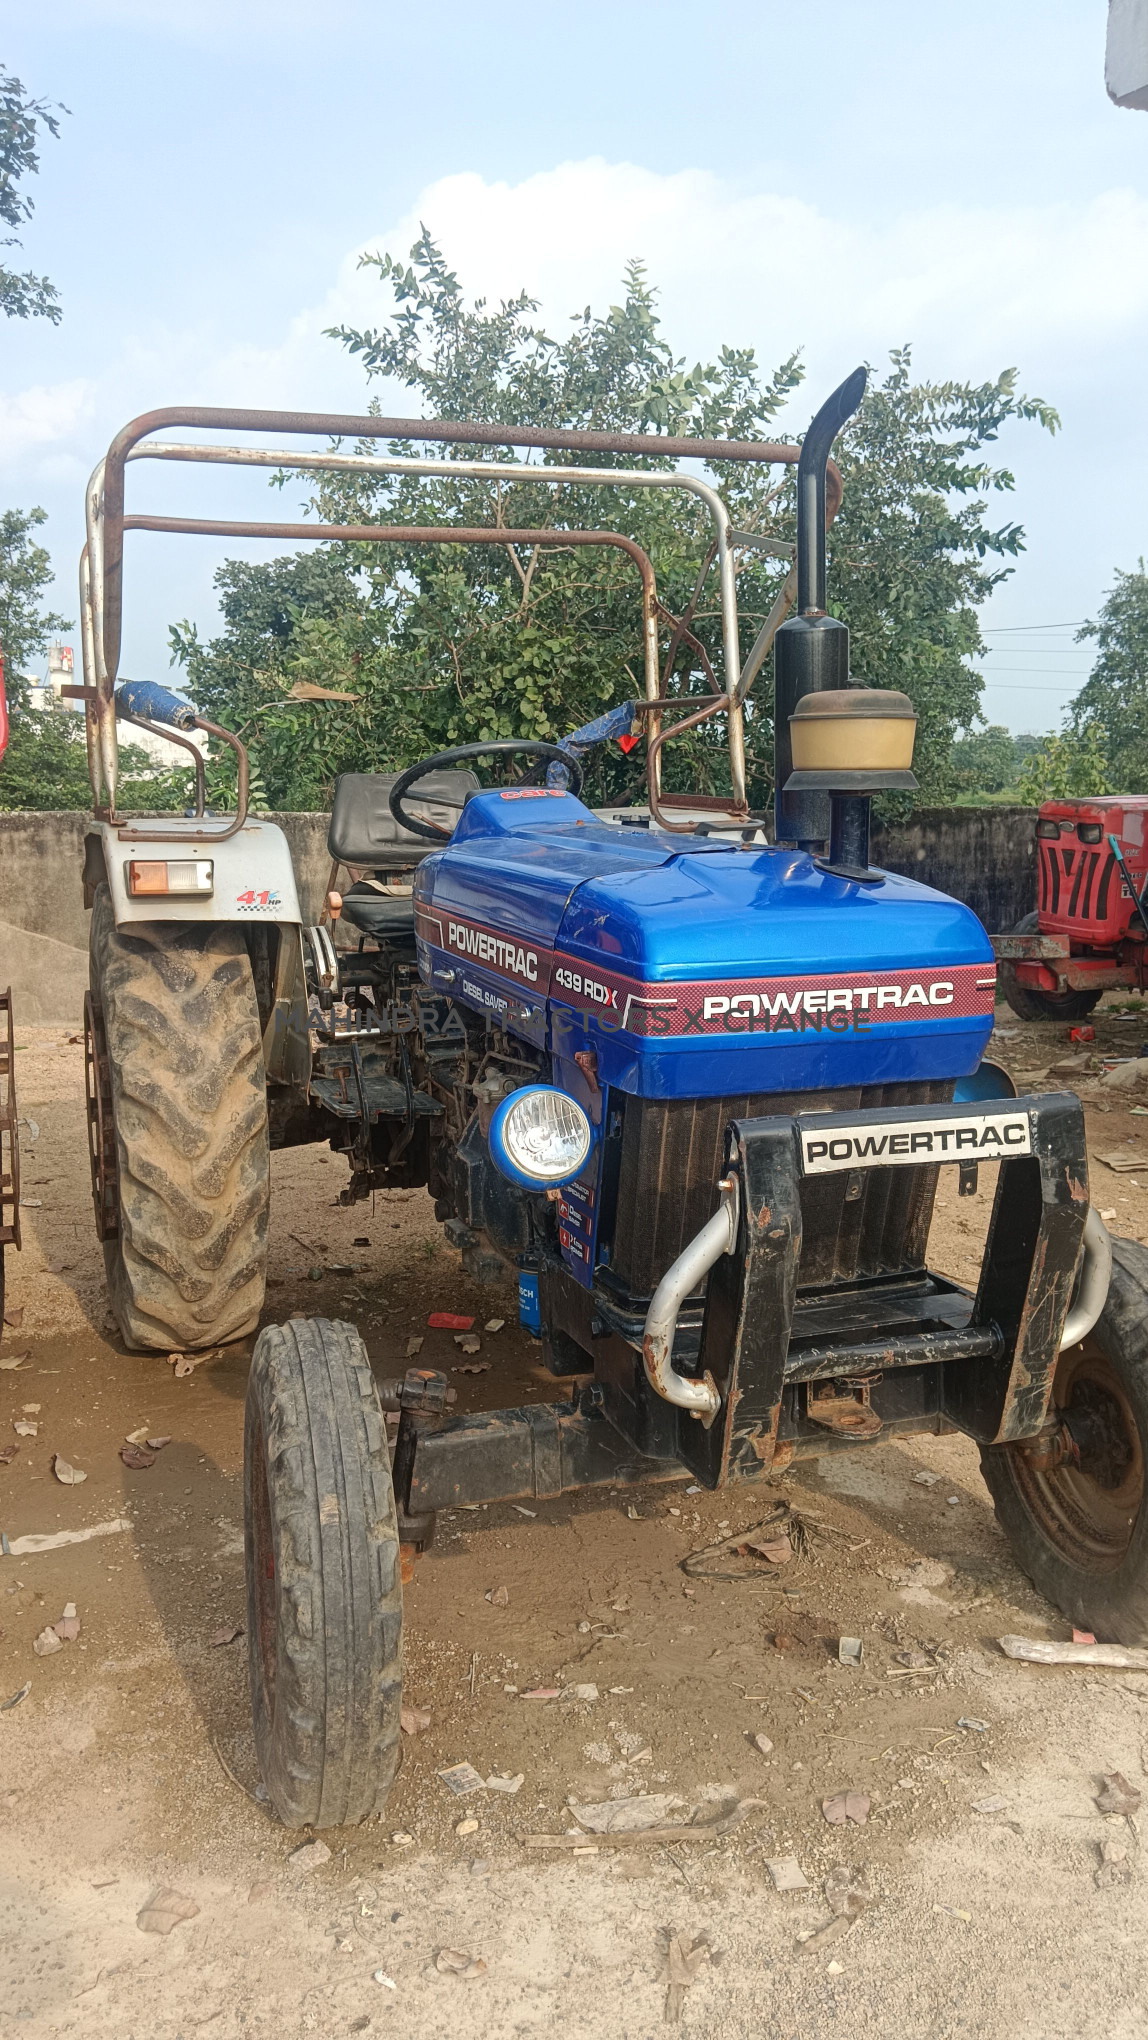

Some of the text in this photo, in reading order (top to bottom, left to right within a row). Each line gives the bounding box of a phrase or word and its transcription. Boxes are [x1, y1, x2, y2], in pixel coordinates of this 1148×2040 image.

[500, 789, 567, 799] care
[236, 890, 270, 904] 41
[448, 921, 538, 982] POWERTRAC
[462, 980, 485, 1003] DIESEL
[555, 967, 618, 1010] 439 RDX
[703, 982, 954, 1020] POWERTRAC
[806, 1123, 1025, 1163] POWERTRAC
[519, 1285, 534, 1299] SCH
